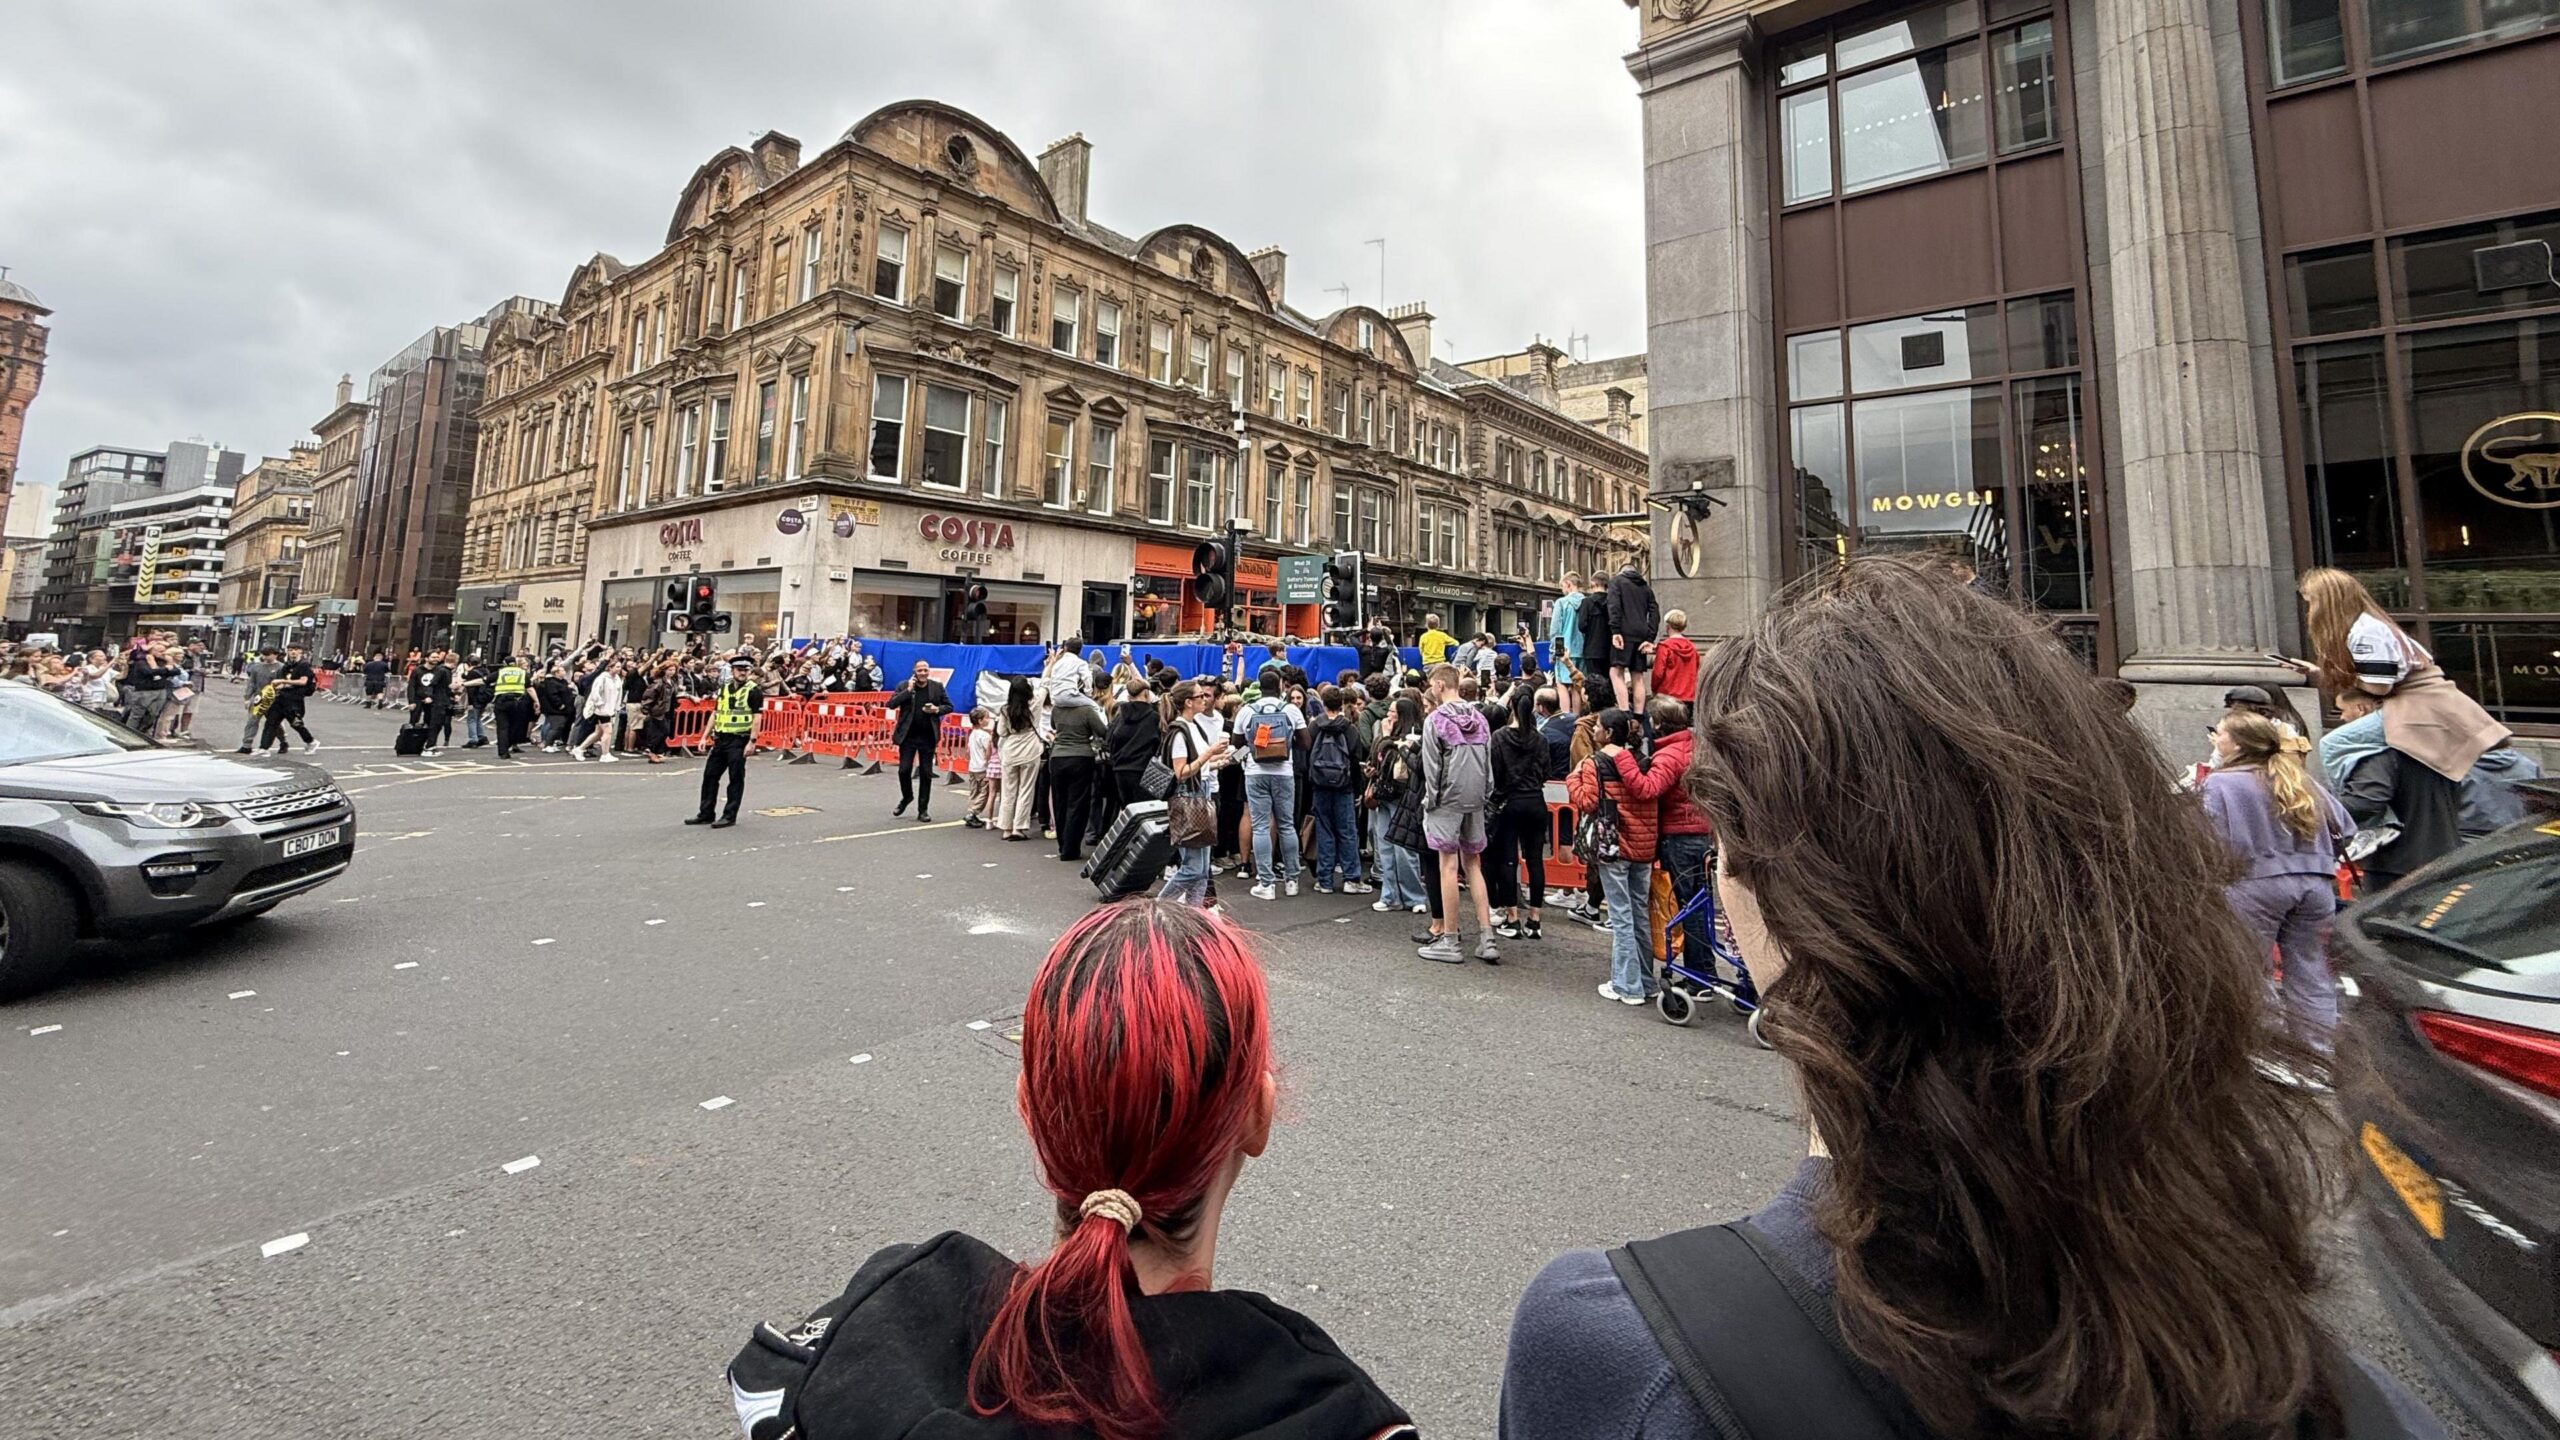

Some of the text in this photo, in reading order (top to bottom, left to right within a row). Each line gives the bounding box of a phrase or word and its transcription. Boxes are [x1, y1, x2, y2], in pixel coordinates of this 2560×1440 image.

[1872, 490, 1993, 512] MOWGLI
[781, 516, 802, 524] COSTA
[660, 518, 703, 546] COSTA
[919, 514, 1015, 548] COSTA
[668, 550, 692, 562] COFFEE
[940, 549, 992, 564] COFFEE
[1432, 585, 1460, 597] CHAAKOO
[543, 597, 564, 609] blitz
[287, 829, 337, 855] CB07 DON
